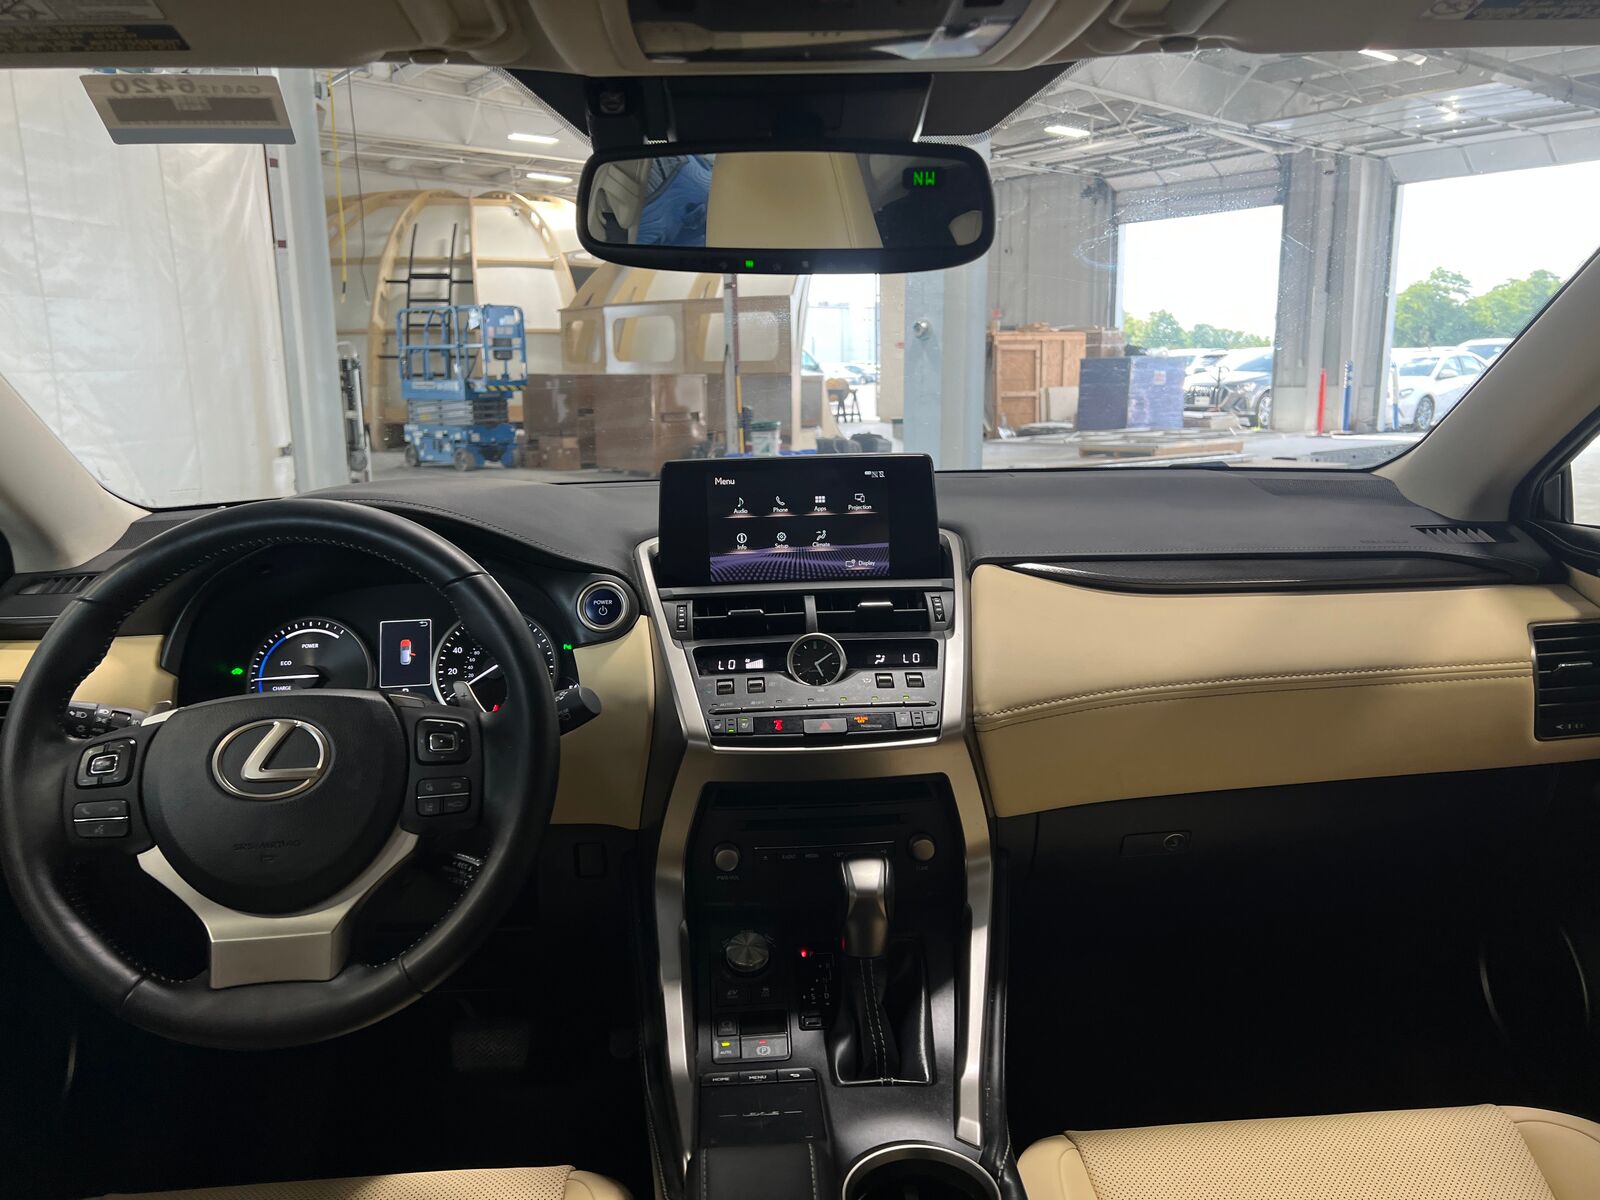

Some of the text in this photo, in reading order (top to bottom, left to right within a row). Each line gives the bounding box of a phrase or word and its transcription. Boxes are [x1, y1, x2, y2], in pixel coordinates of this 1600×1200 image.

[913, 170, 935, 186] NW
[714, 477, 735, 485] Menu
[903, 653, 920, 663] LO
[718, 659, 736, 670] LO
